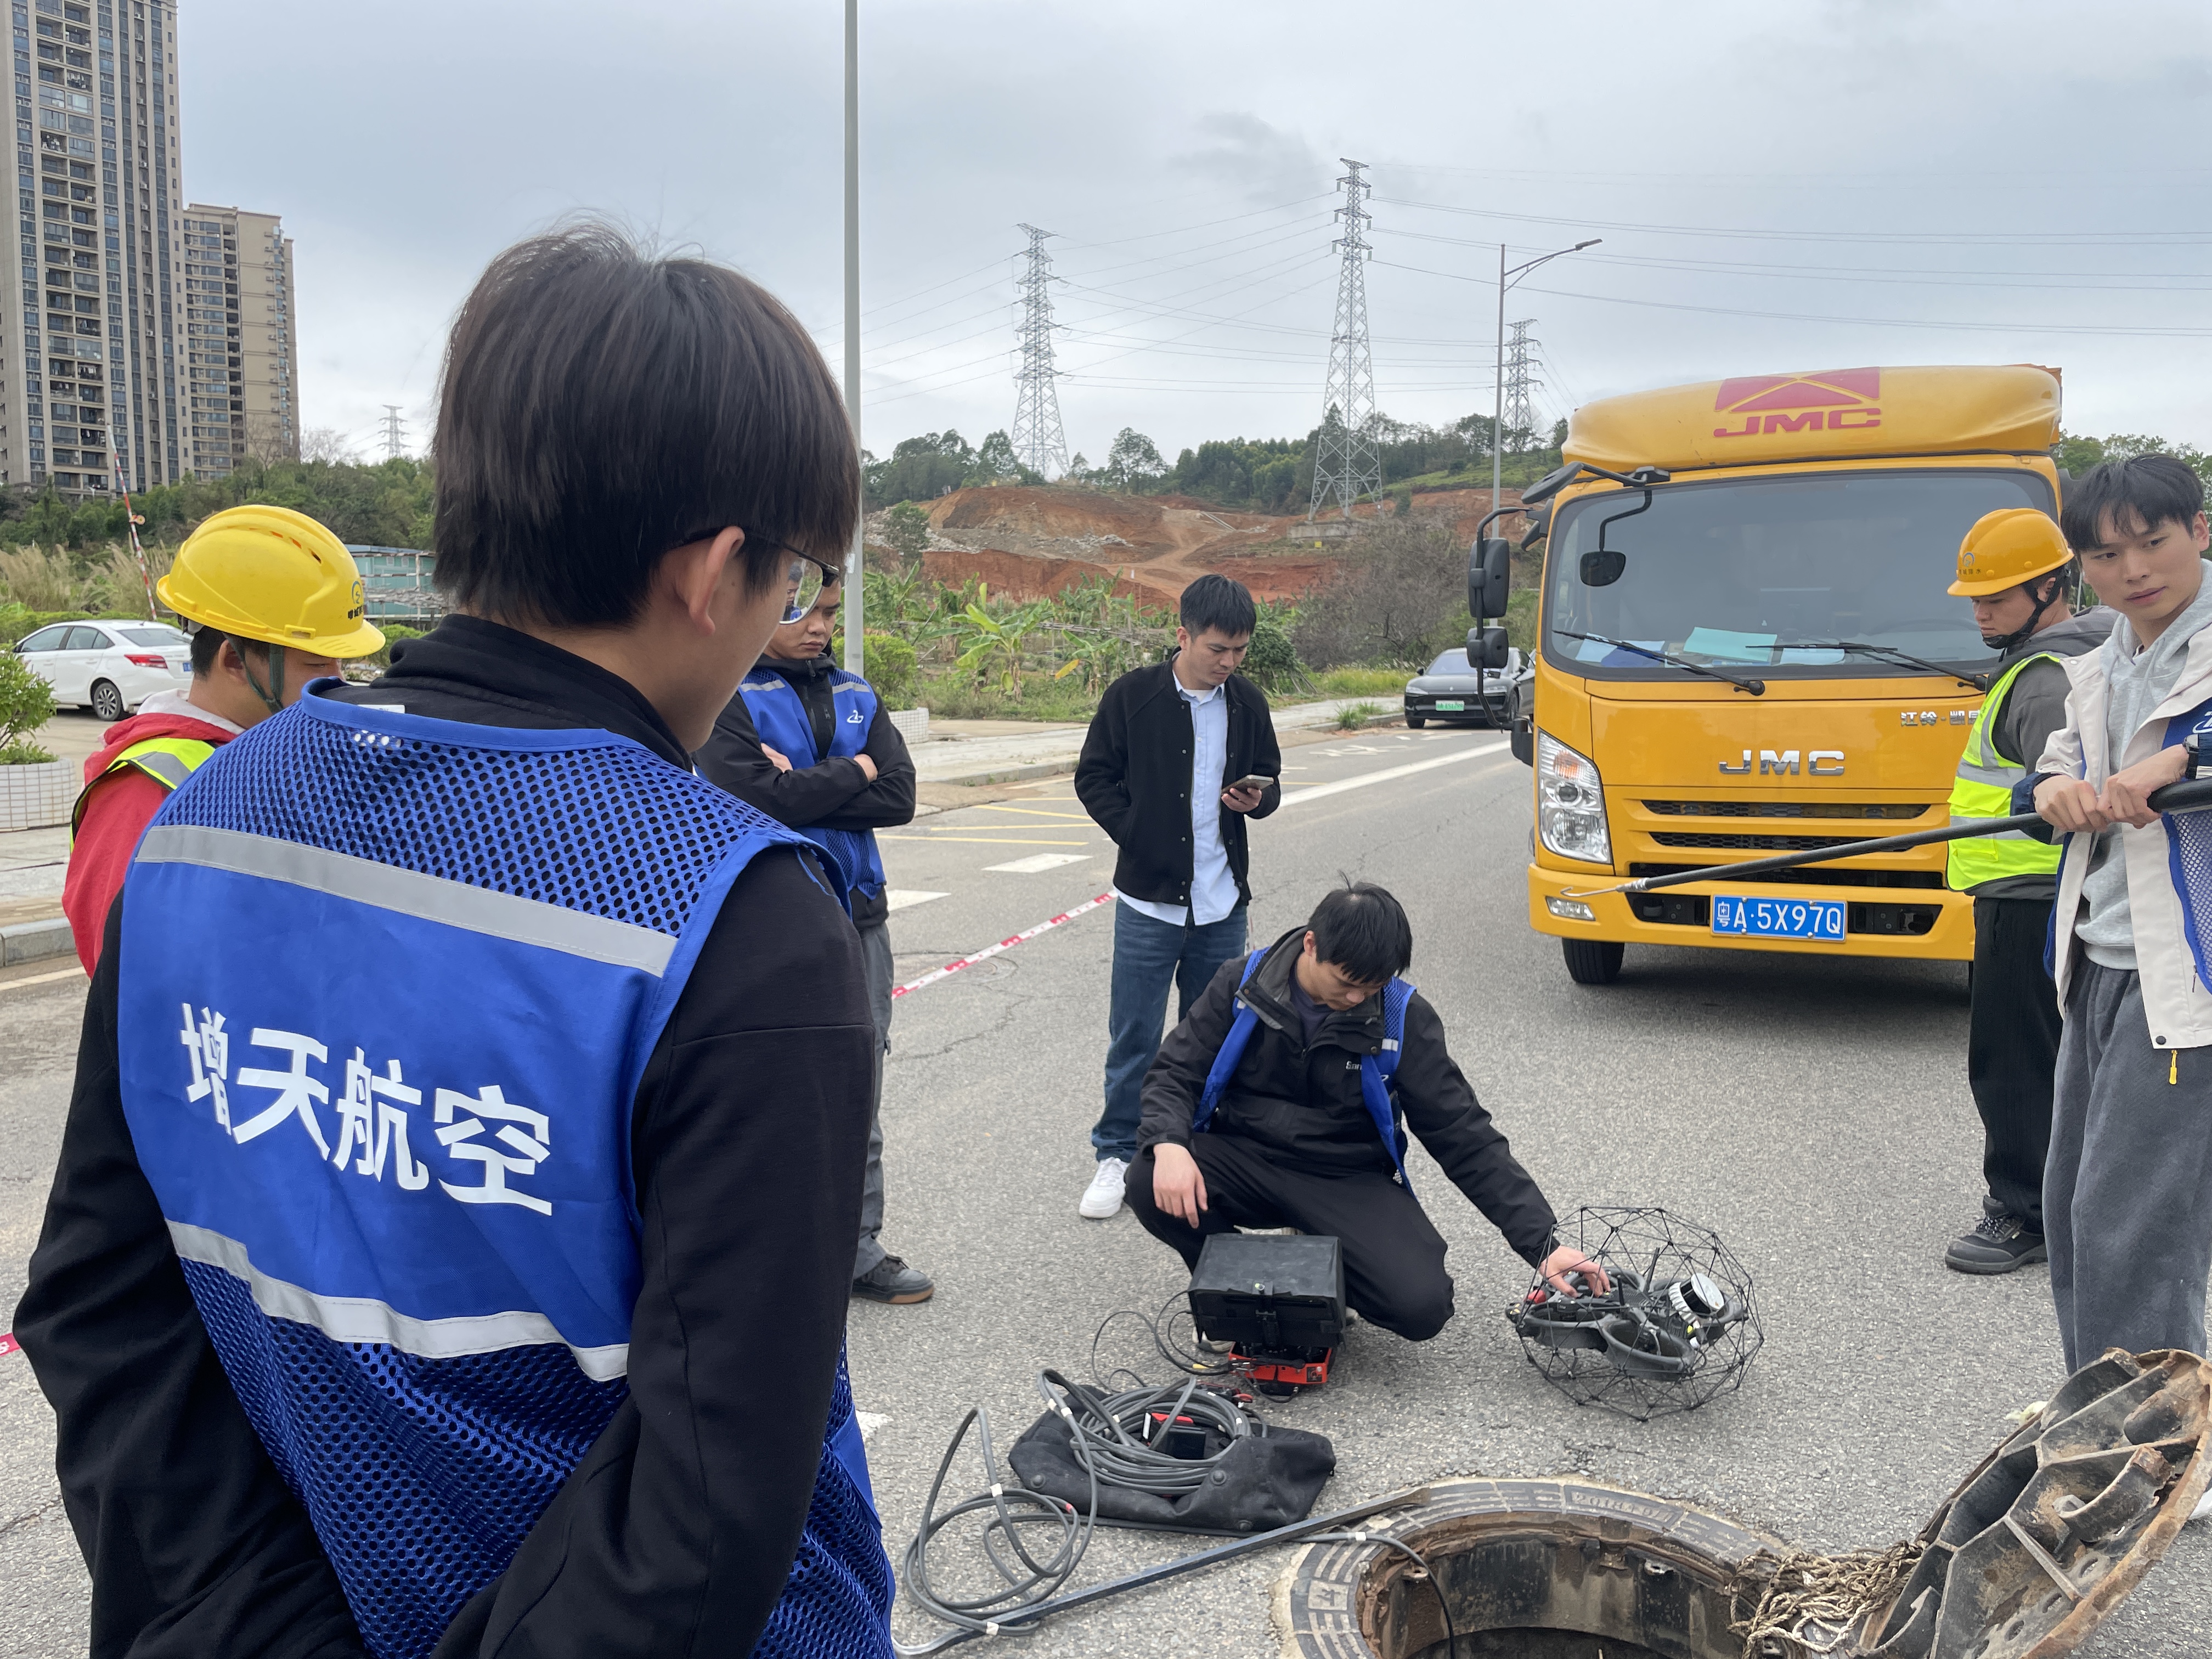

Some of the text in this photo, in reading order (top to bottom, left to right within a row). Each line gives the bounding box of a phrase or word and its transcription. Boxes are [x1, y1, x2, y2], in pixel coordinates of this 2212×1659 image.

[1713, 408, 1881, 437] JMC
[1718, 749, 1844, 775] JMC
[180, 1003, 552, 1216] 增天航空
